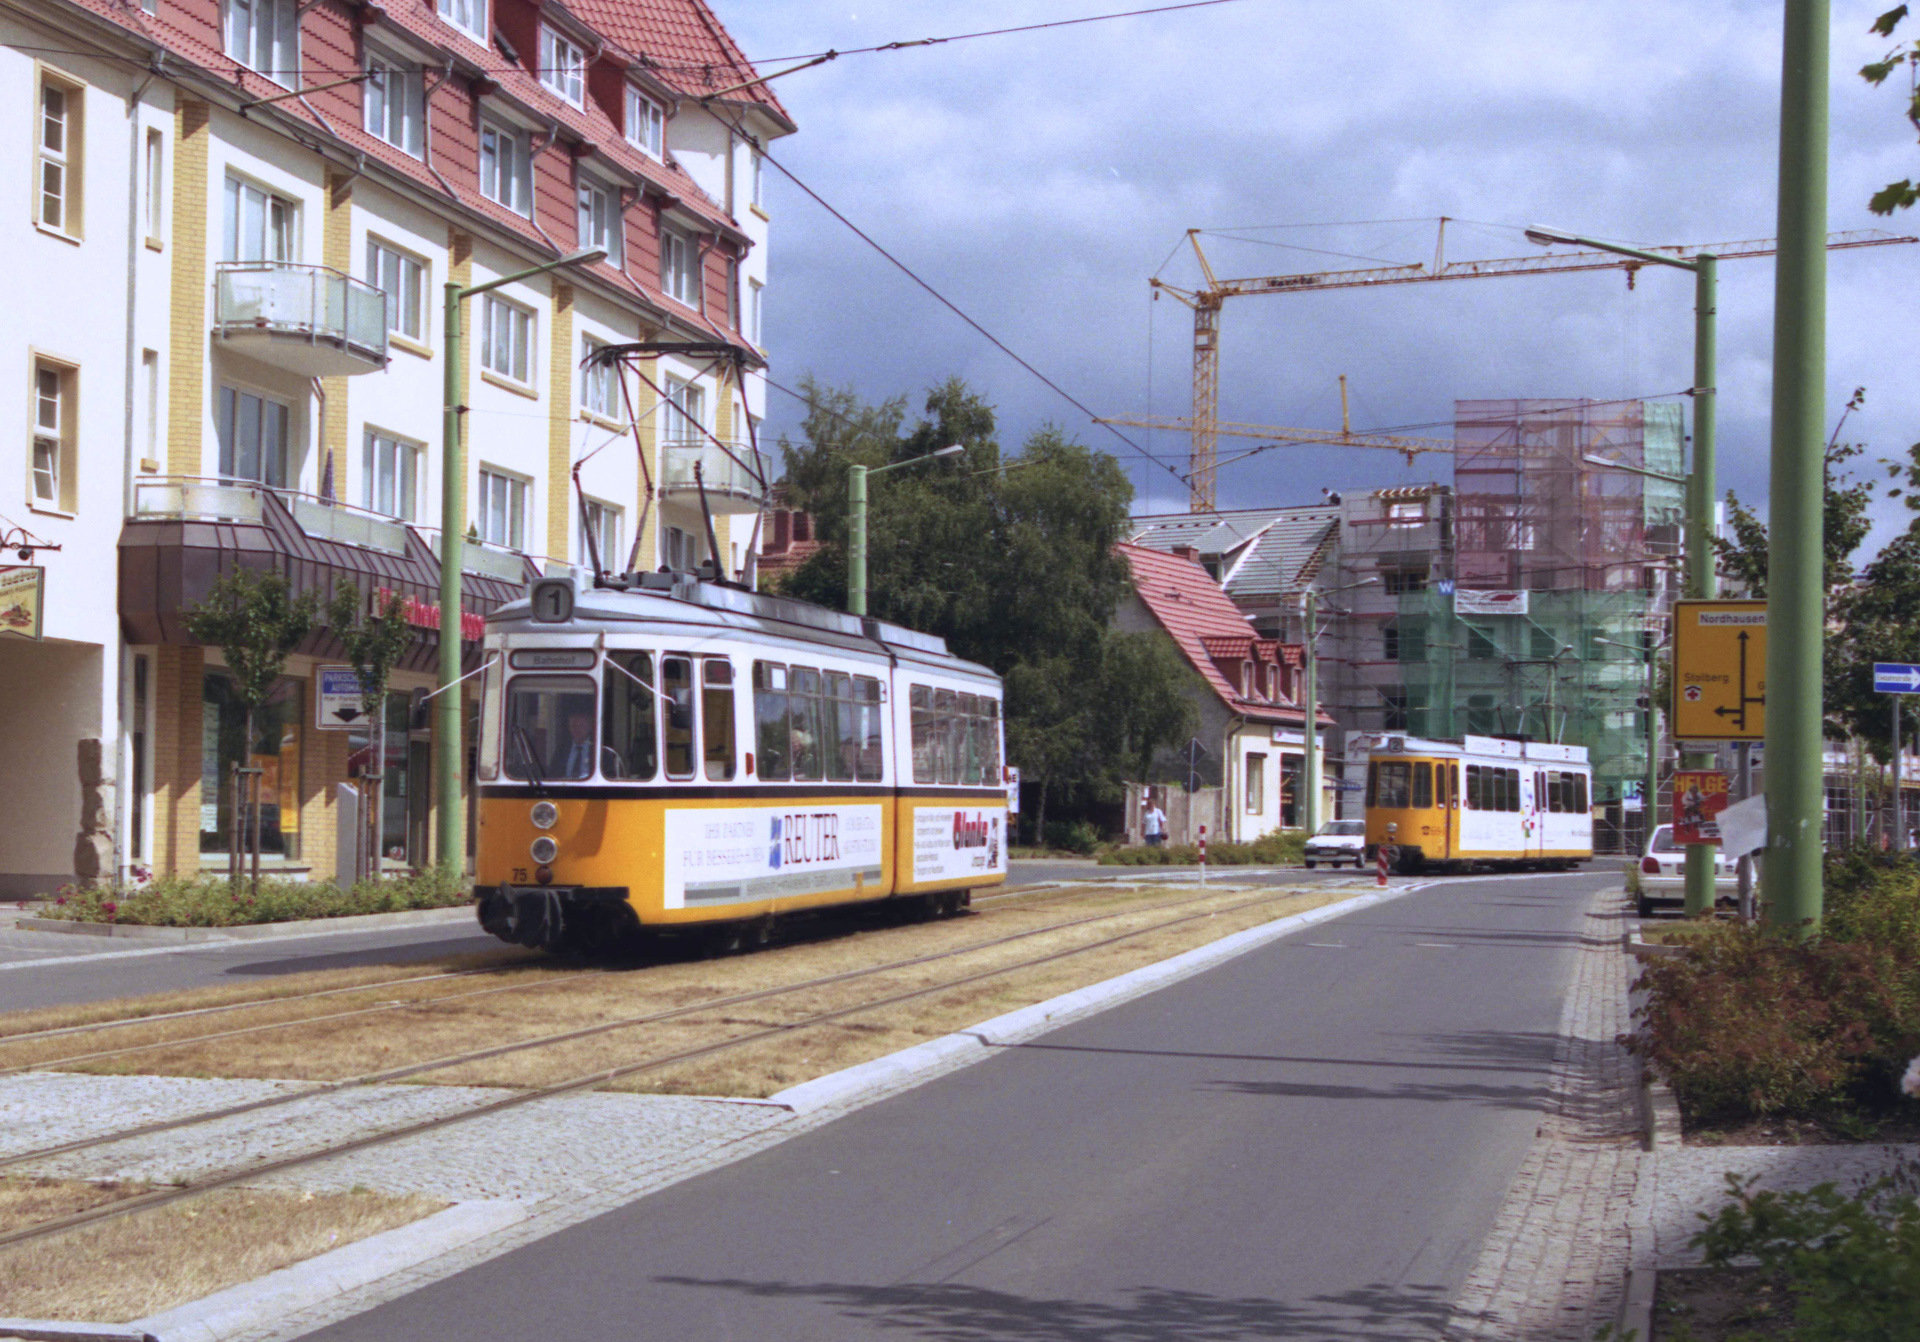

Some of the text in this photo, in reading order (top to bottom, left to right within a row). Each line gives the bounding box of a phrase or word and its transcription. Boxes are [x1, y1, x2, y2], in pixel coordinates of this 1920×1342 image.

[548, 589, 561, 616] 1
[1684, 672, 1730, 685] Stolberg
[1674, 774, 1728, 793] HELGE
[784, 812, 840, 865] REUTER
[512, 868, 528, 882] 75
